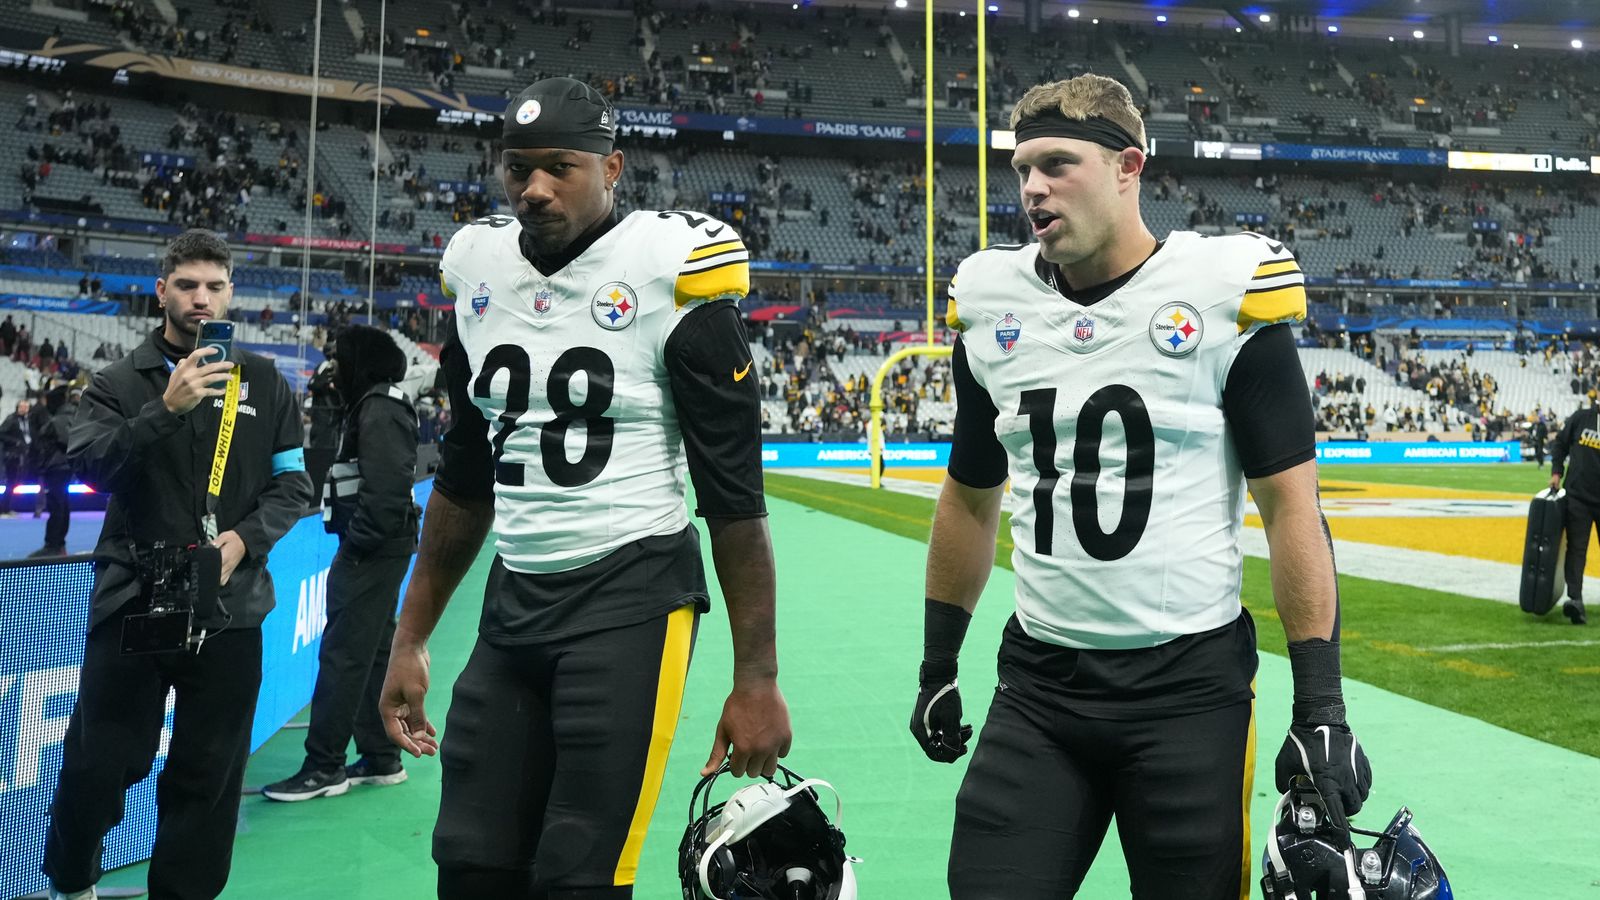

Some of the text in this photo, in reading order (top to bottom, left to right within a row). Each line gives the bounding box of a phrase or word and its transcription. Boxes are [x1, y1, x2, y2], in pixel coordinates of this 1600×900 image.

[622, 109, 673, 125] GAME
[816, 122, 906, 139] PARIS GAME
[1311, 148, 1348, 160] STADE
[1357, 150, 1400, 163] FRANCE
[535, 299, 550, 310] NFL
[596, 300, 614, 308] Steelers
[1075, 326, 1092, 339] NFL
[1155, 322, 1175, 331] Steelers
[1000, 330, 1016, 338] PARIS
[237, 403, 257, 417] MEDIA
[474, 344, 615, 487] 28
[211, 419, 233, 488] OFF-WHITE
[817, 449, 937, 461] AMERICA EXPRESS
[1323, 447, 1372, 458] EXPRESS
[1404, 447, 1505, 459] AMERICAN EXPRESS
[1016, 383, 1156, 562] 10
